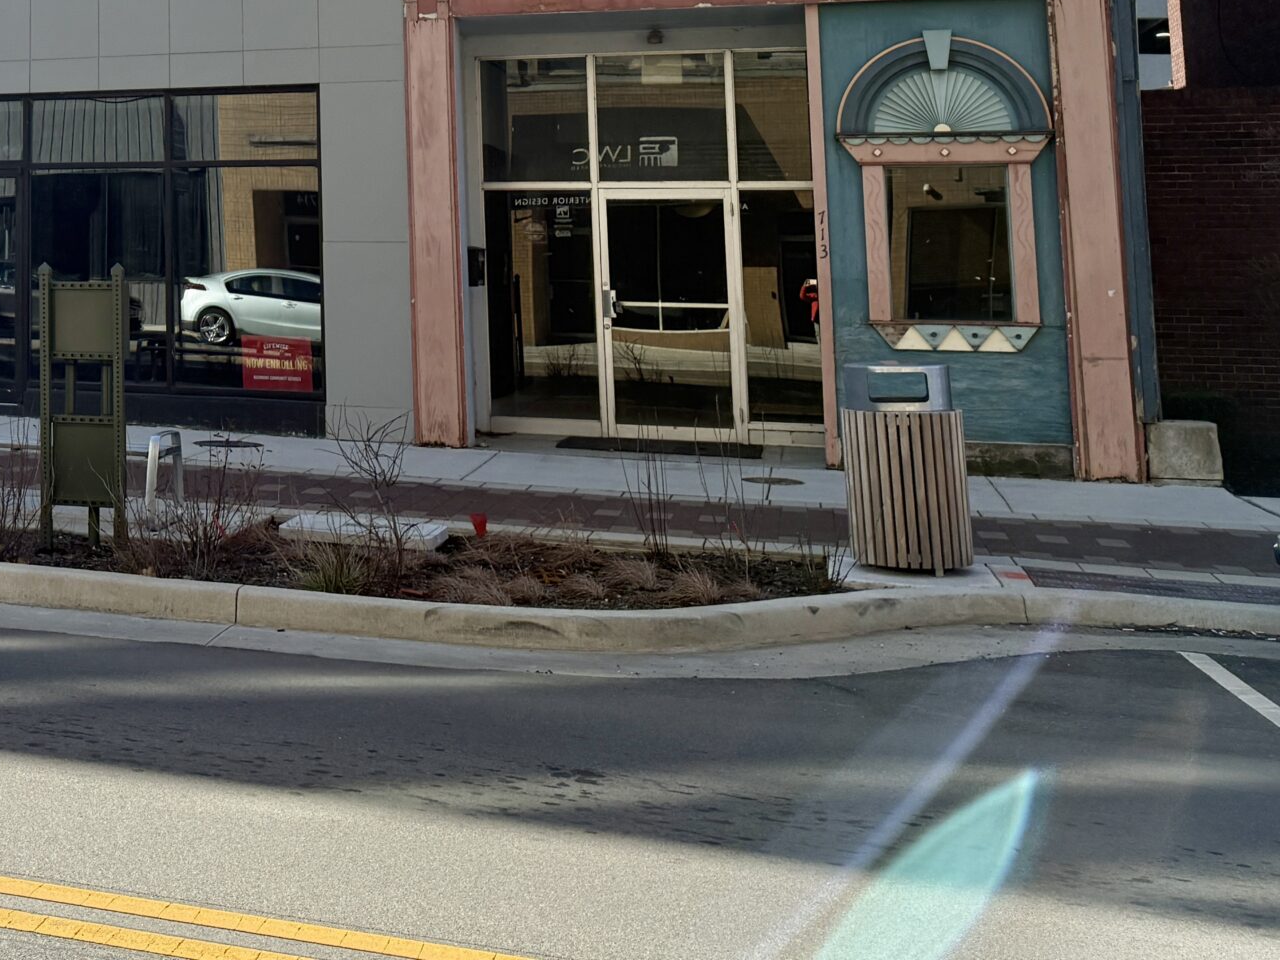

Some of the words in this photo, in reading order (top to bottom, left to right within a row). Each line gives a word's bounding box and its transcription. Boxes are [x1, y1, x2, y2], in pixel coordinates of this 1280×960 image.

[818, 210, 828, 259] 713
[246, 357, 265, 369] NOW
[265, 358, 308, 371] ENROLLING
